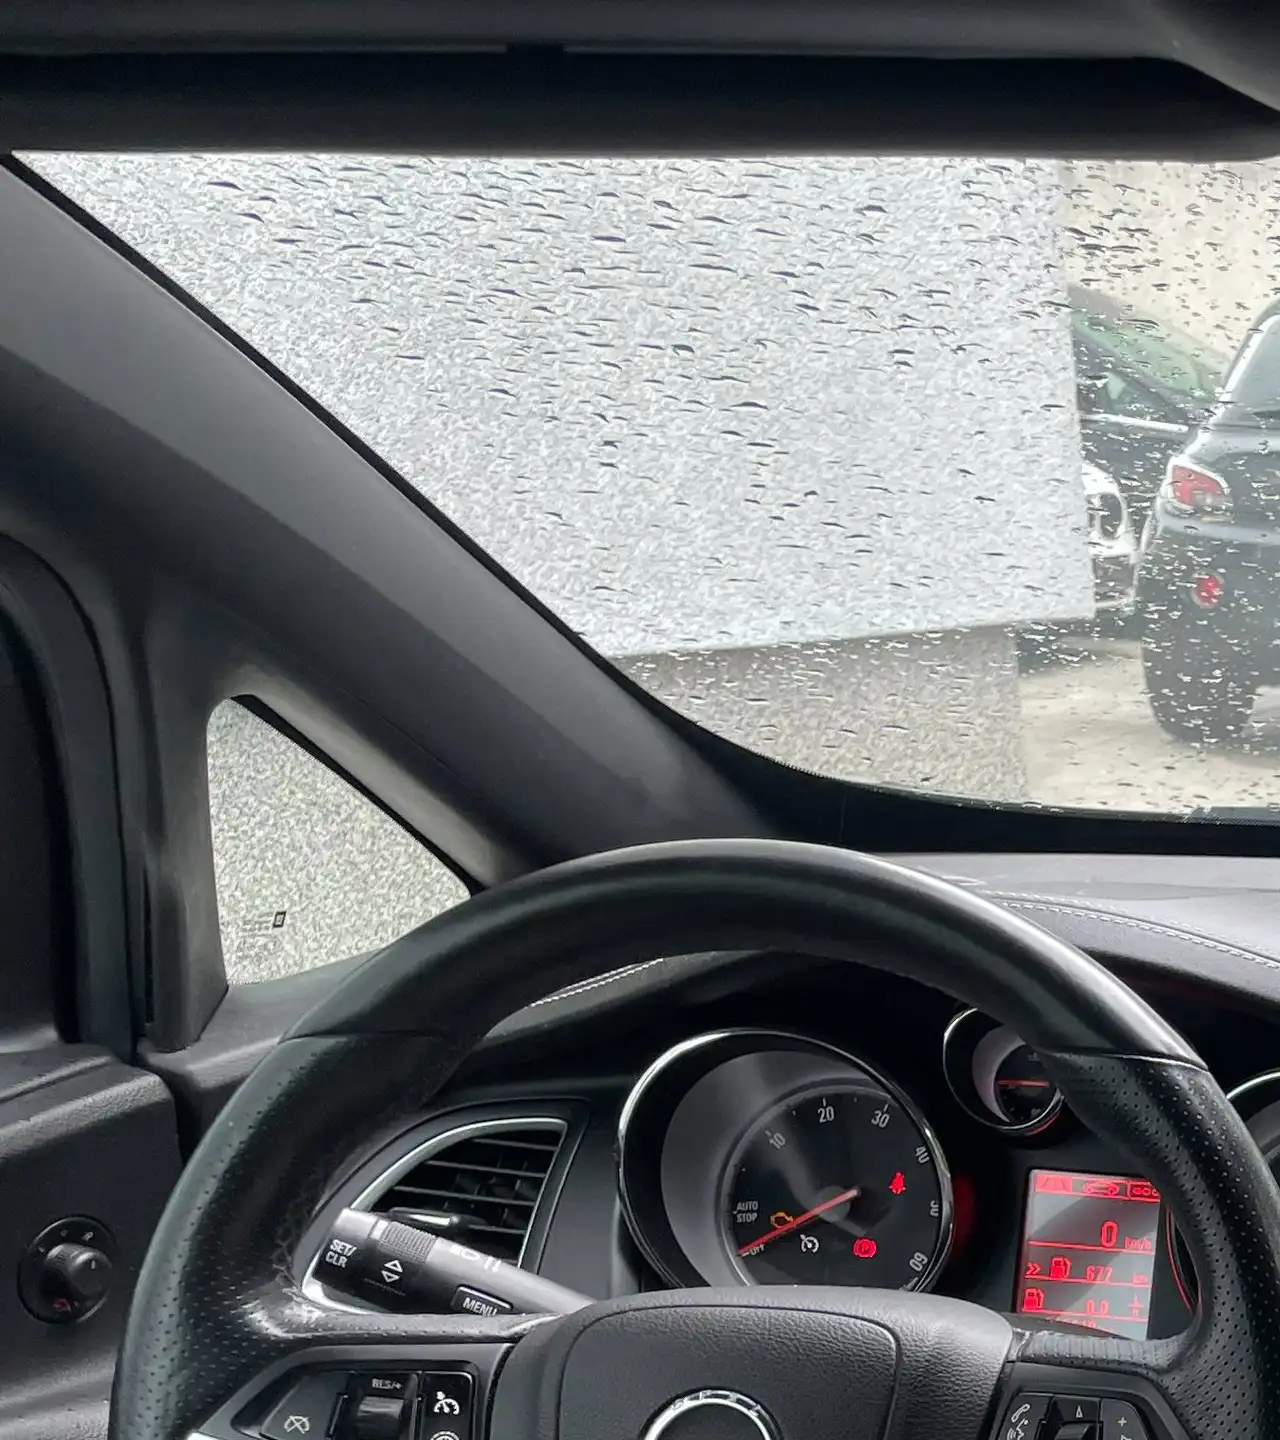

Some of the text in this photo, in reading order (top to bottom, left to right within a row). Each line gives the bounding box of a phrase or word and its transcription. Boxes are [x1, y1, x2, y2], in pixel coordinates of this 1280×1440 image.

[818, 1107, 834, 1122] 20
[871, 1110, 890, 1127] 30
[769, 1132, 786, 1149] 10
[736, 1201, 759, 1211] AUTO
[736, 1212, 758, 1223] STOP
[1101, 1221, 1118, 1248] 0
[330, 1238, 357, 1256] SET/
[325, 1251, 349, 1269] CLR
[909, 1252, 928, 1271] 60
[462, 1297, 498, 1317] MENU
